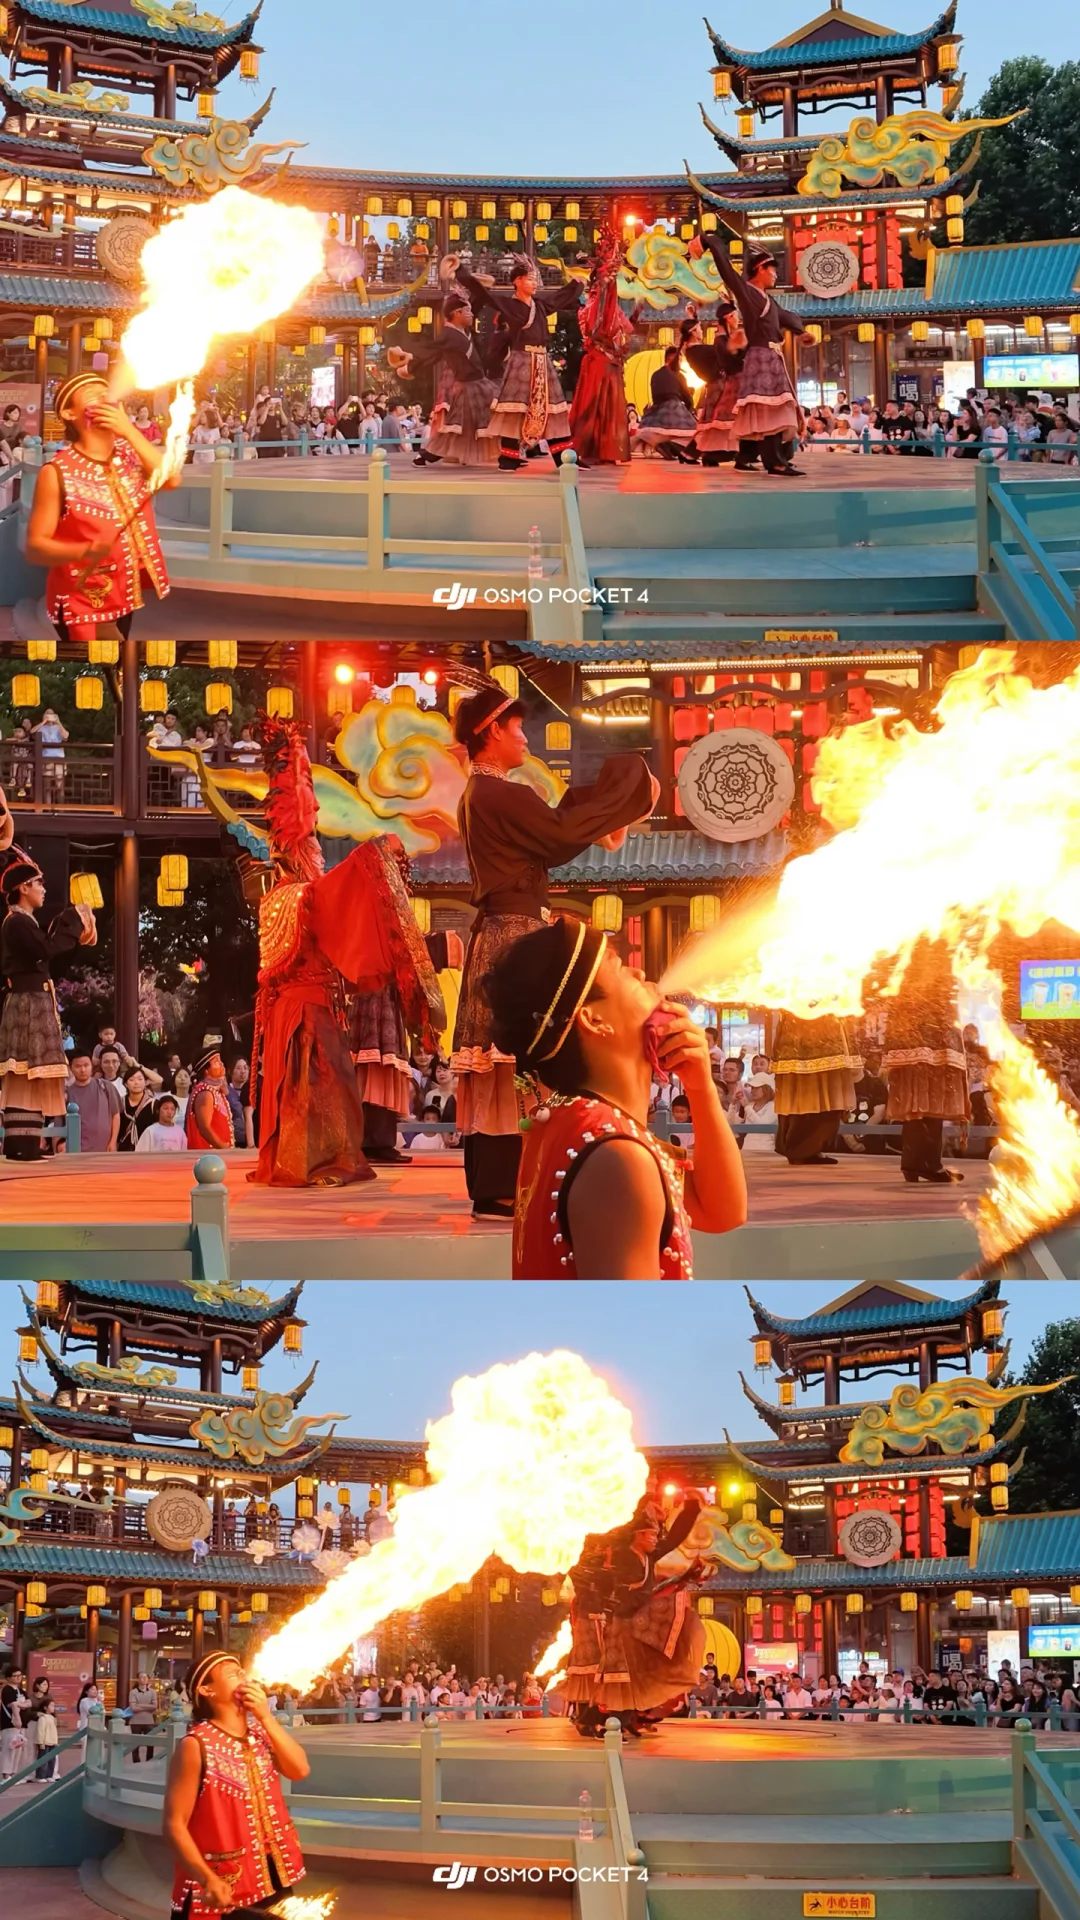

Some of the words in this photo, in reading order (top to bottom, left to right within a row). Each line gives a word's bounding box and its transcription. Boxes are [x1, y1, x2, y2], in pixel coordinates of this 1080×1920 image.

[899, 383, 919, 402] 喝
[942, 1653, 963, 1672] 喝
[827, 1896, 871, 1909] 小心台阶
